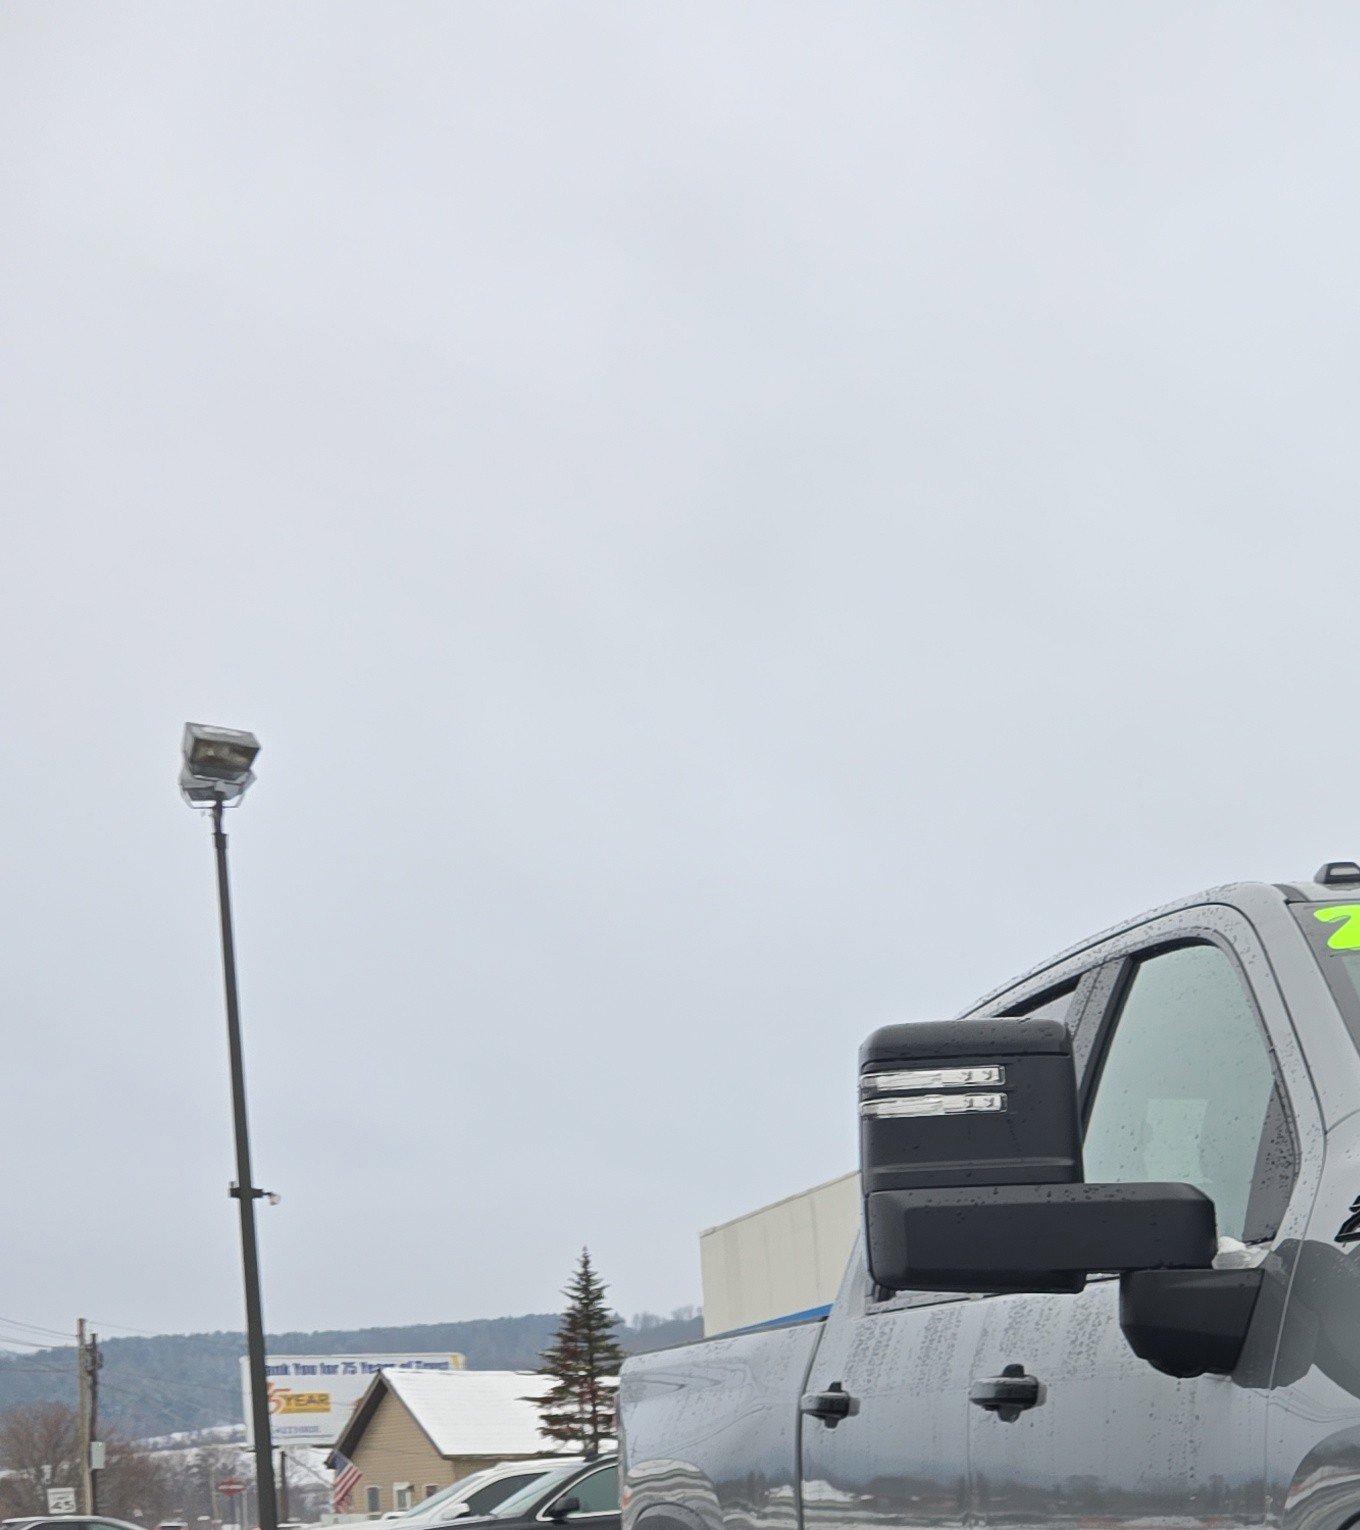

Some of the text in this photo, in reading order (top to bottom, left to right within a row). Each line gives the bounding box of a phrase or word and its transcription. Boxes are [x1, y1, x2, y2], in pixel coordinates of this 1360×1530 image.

[342, 1361, 358, 1376] 75
[281, 1392, 331, 1407] YEAR
[51, 1500, 75, 1511] 45
